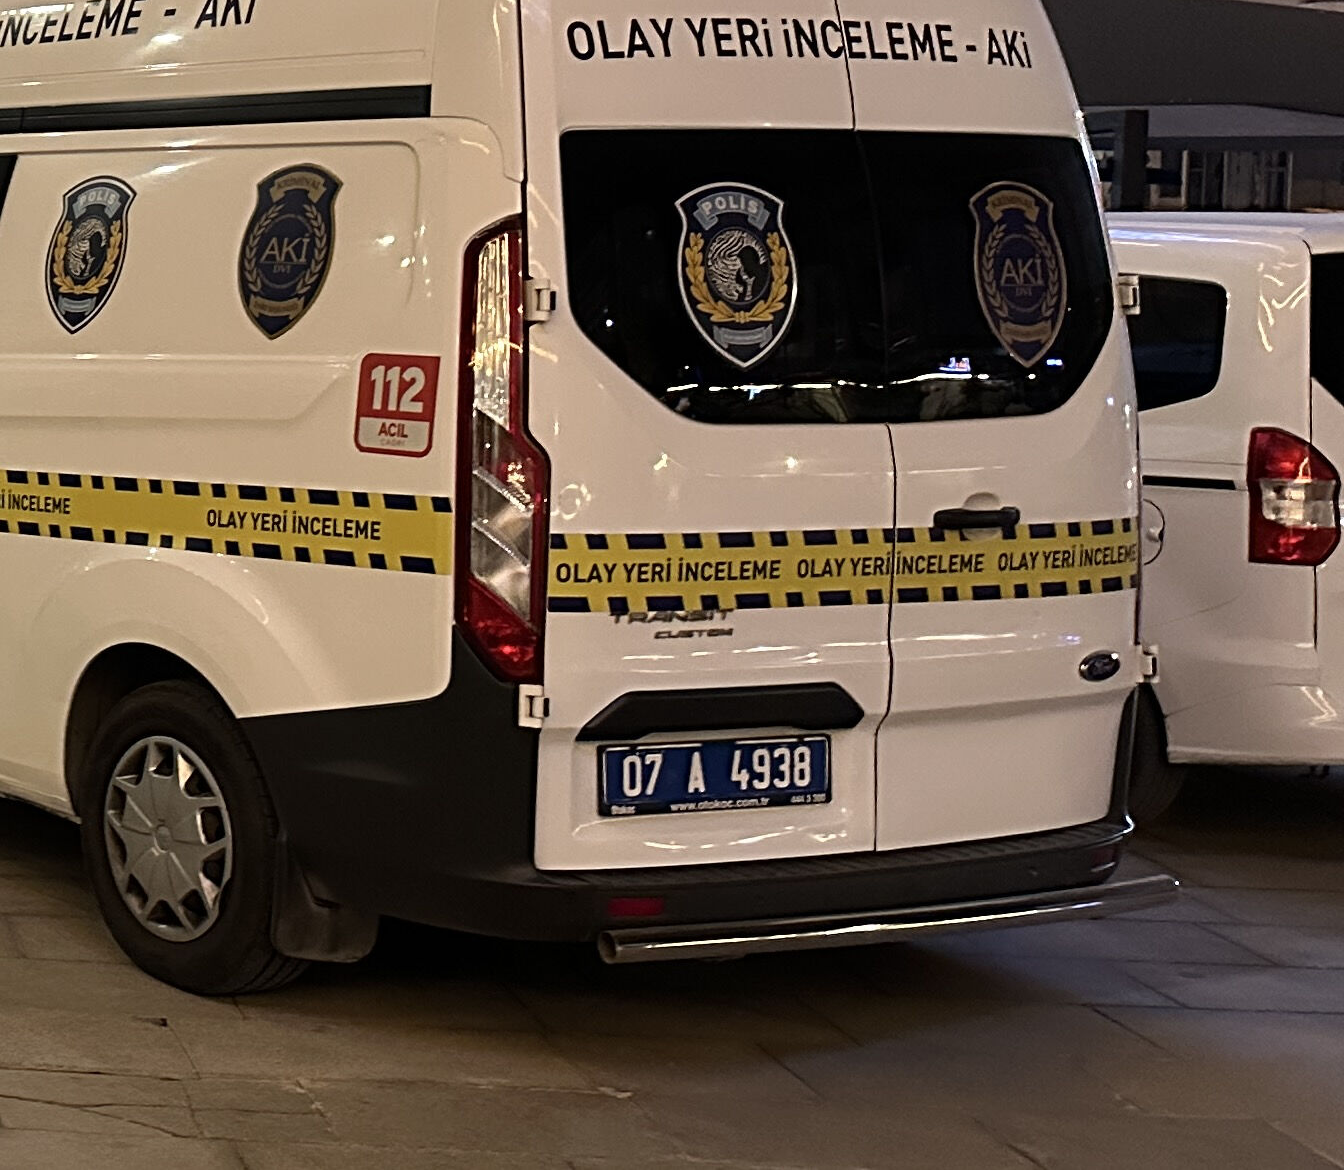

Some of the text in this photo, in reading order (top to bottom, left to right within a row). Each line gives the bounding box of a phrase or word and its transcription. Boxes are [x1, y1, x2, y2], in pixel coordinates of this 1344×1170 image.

[566, 17, 673, 60] OLAY
[260, 233, 310, 263] AKİ
[1000, 254, 1045, 286] AKİ
[370, 364, 426, 414] 112
[7, 488, 71, 515] İNCELEME
[206, 509, 382, 541] OLAY YERİ İNCELEME
[555, 562, 618, 584] OLAY
[622, 557, 672, 583] YERİ
[677, 556, 782, 582] İNCELEME
[796, 557, 846, 579] OLAY
[849, 551, 892, 577] YERİ
[895, 551, 985, 576] İNCELEME
[997, 550, 1040, 572] OLAY
[1042, 544, 1077, 569] YERİ
[621, 745, 812, 798] 07 A 4938
